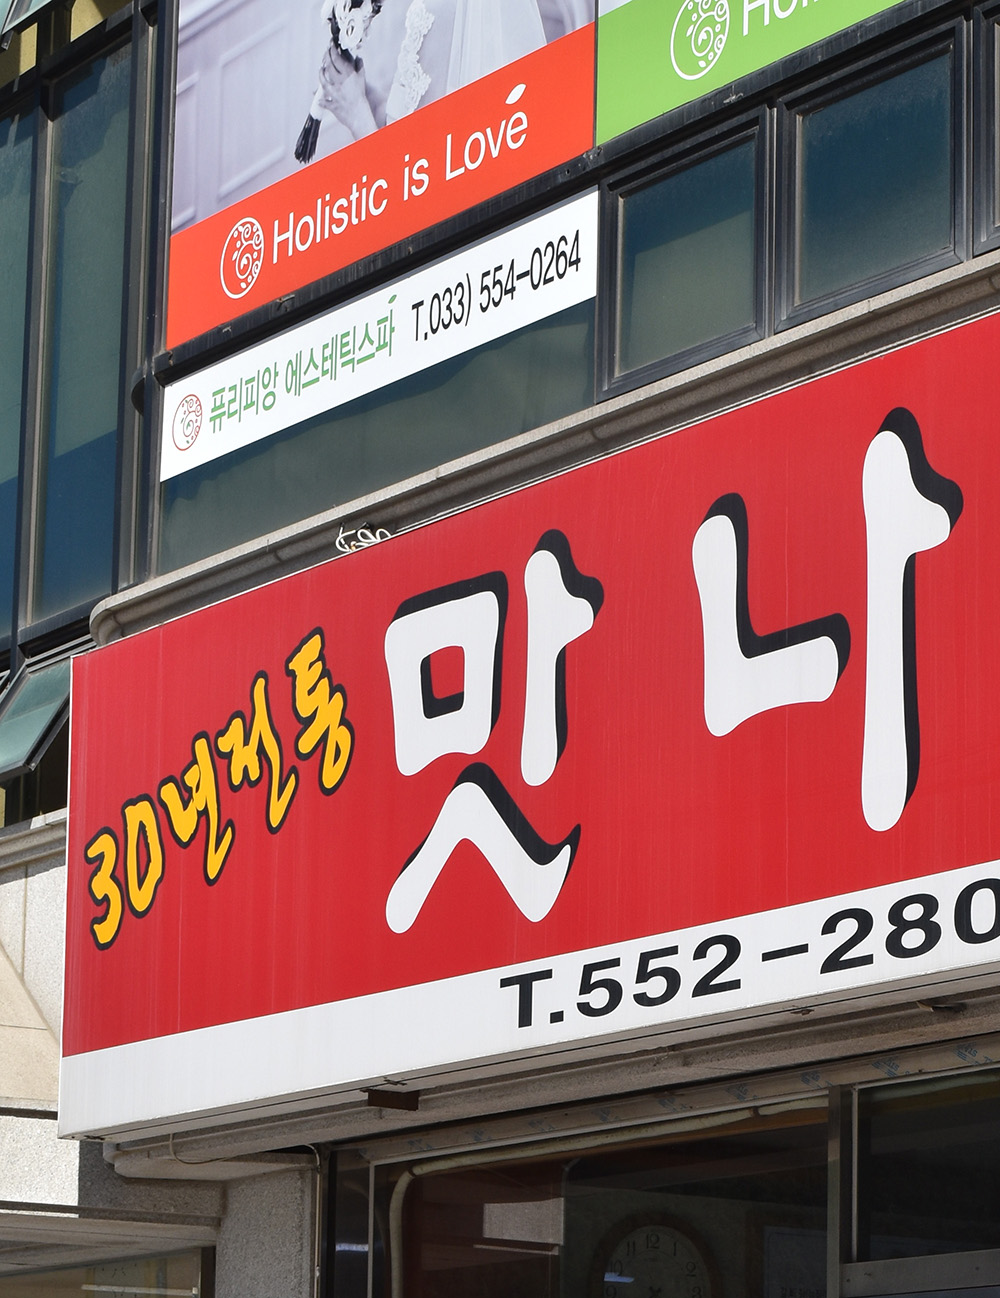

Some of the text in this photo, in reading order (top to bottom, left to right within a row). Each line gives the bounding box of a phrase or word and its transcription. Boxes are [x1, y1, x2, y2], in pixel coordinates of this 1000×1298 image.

[272, 104, 529, 265] Holistic is Love
[209, 229, 581, 434] 퓨리피앙 에스테틱스파 T.033) 554-0264
[84, 626, 355, 950] 30년전통
